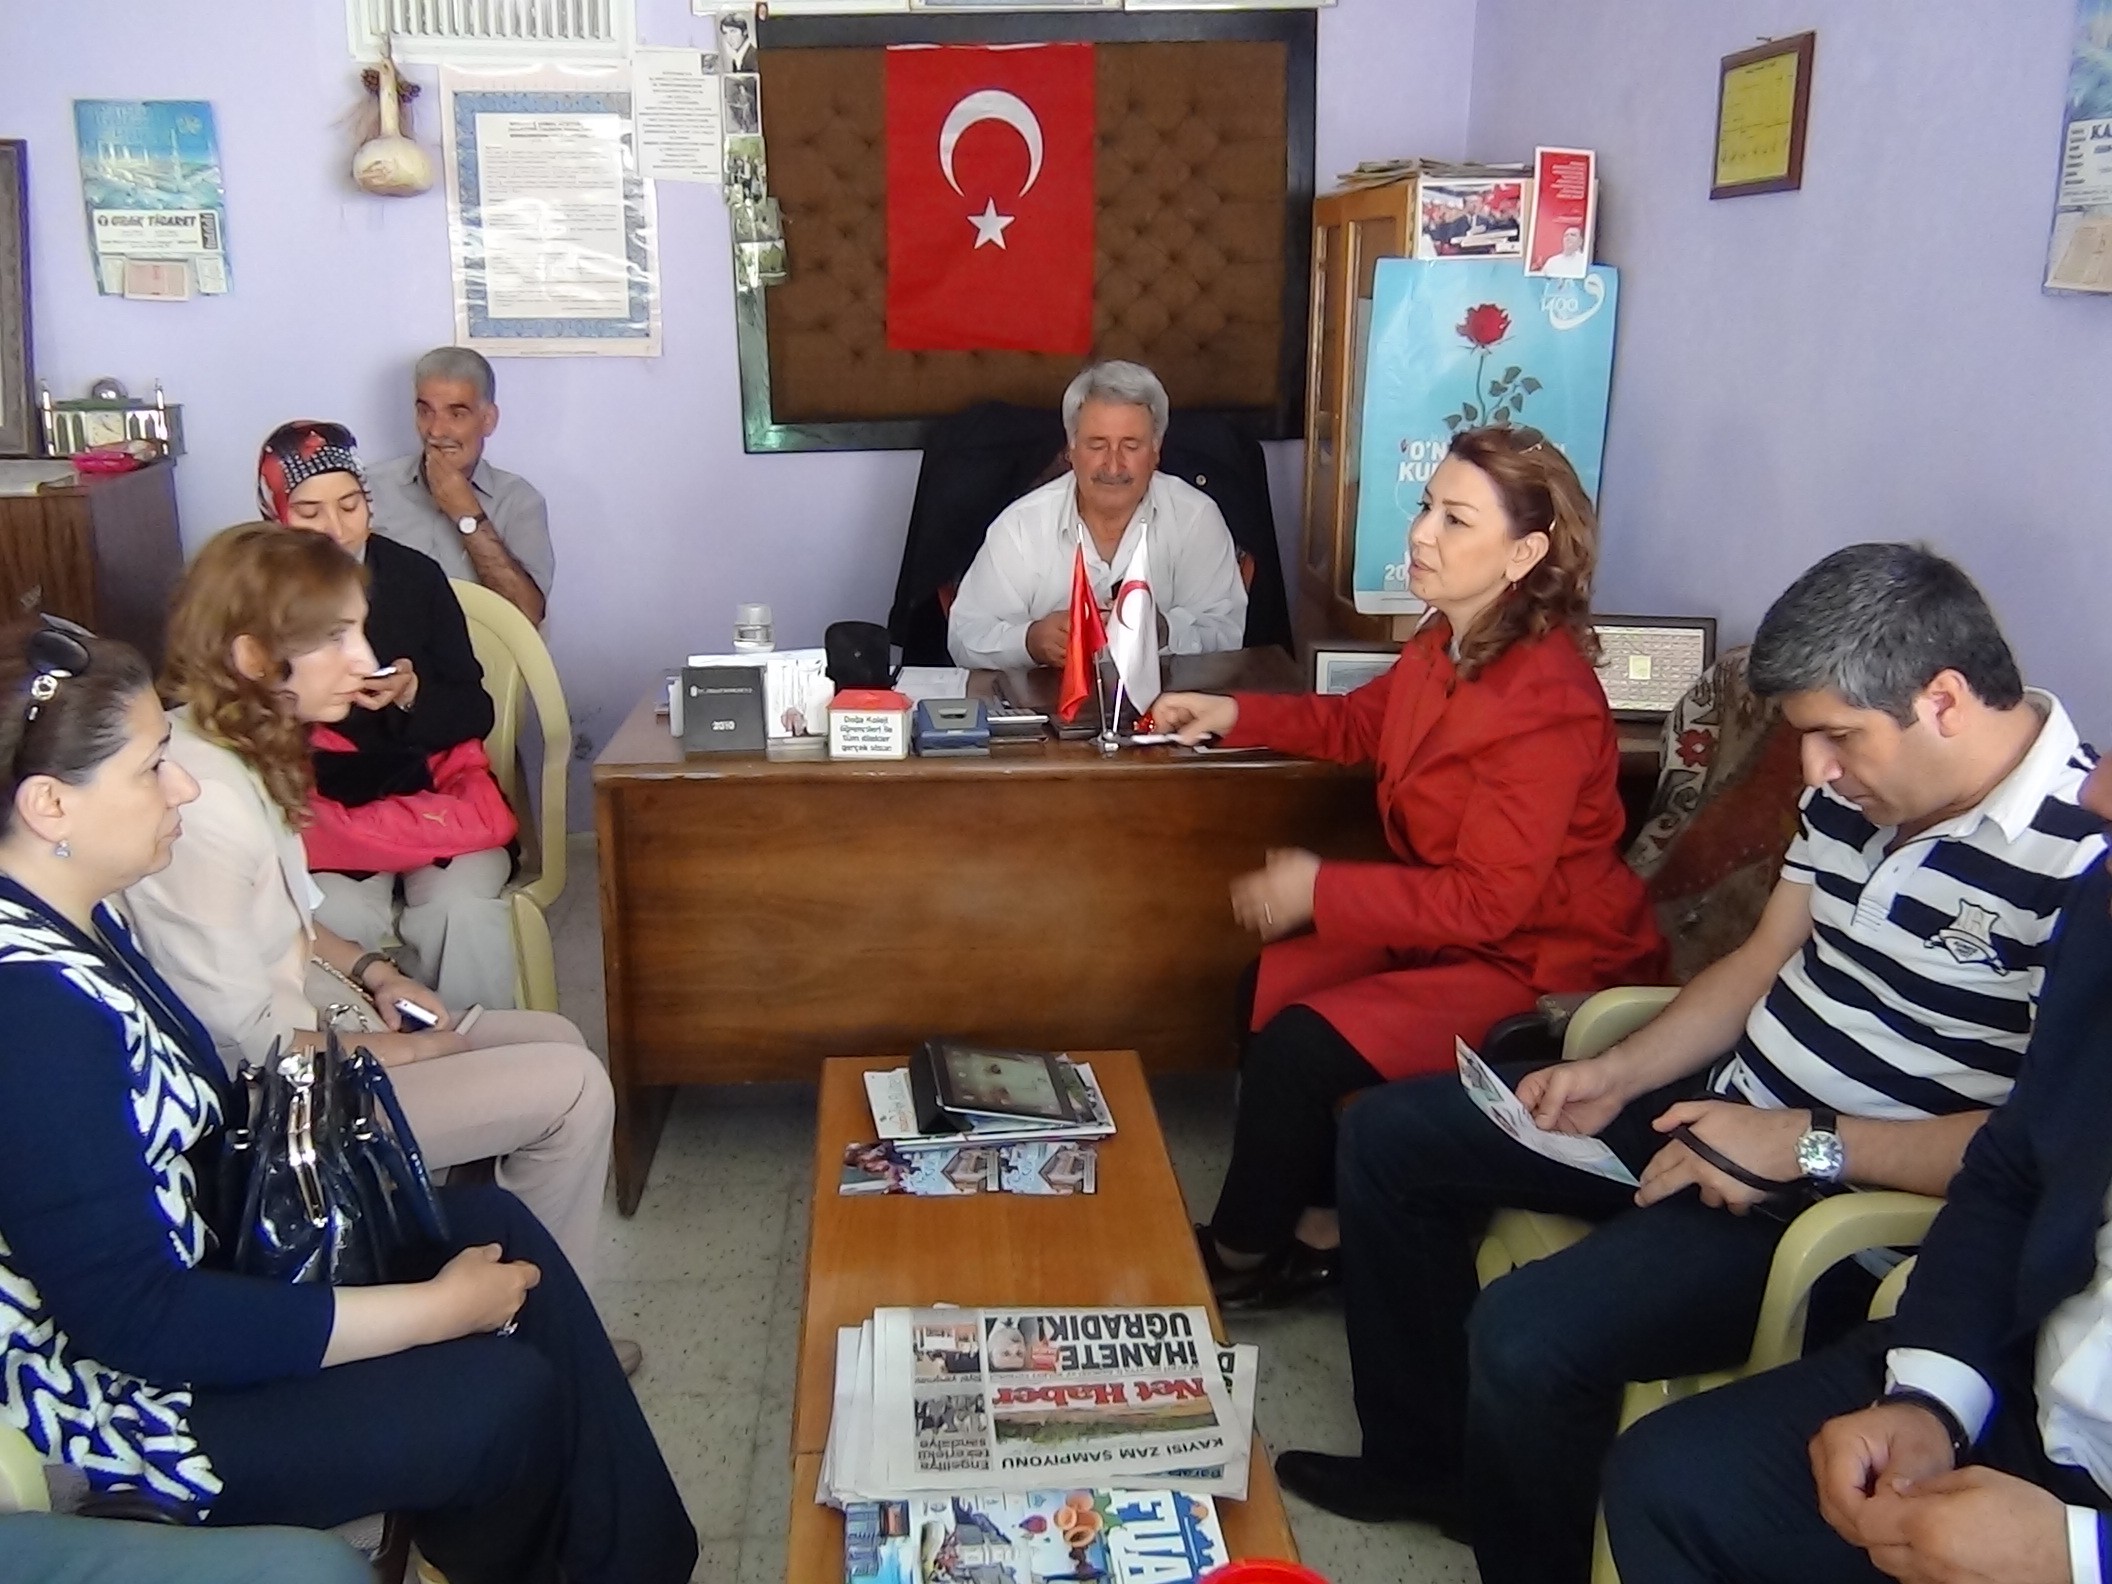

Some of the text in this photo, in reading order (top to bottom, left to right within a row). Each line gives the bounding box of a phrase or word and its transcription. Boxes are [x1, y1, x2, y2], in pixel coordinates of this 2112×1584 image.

[992, 1383, 1128, 1407] Haber
[1134, 1377, 1208, 1402] Net
[1120, 1446, 1158, 1460] ZAM
